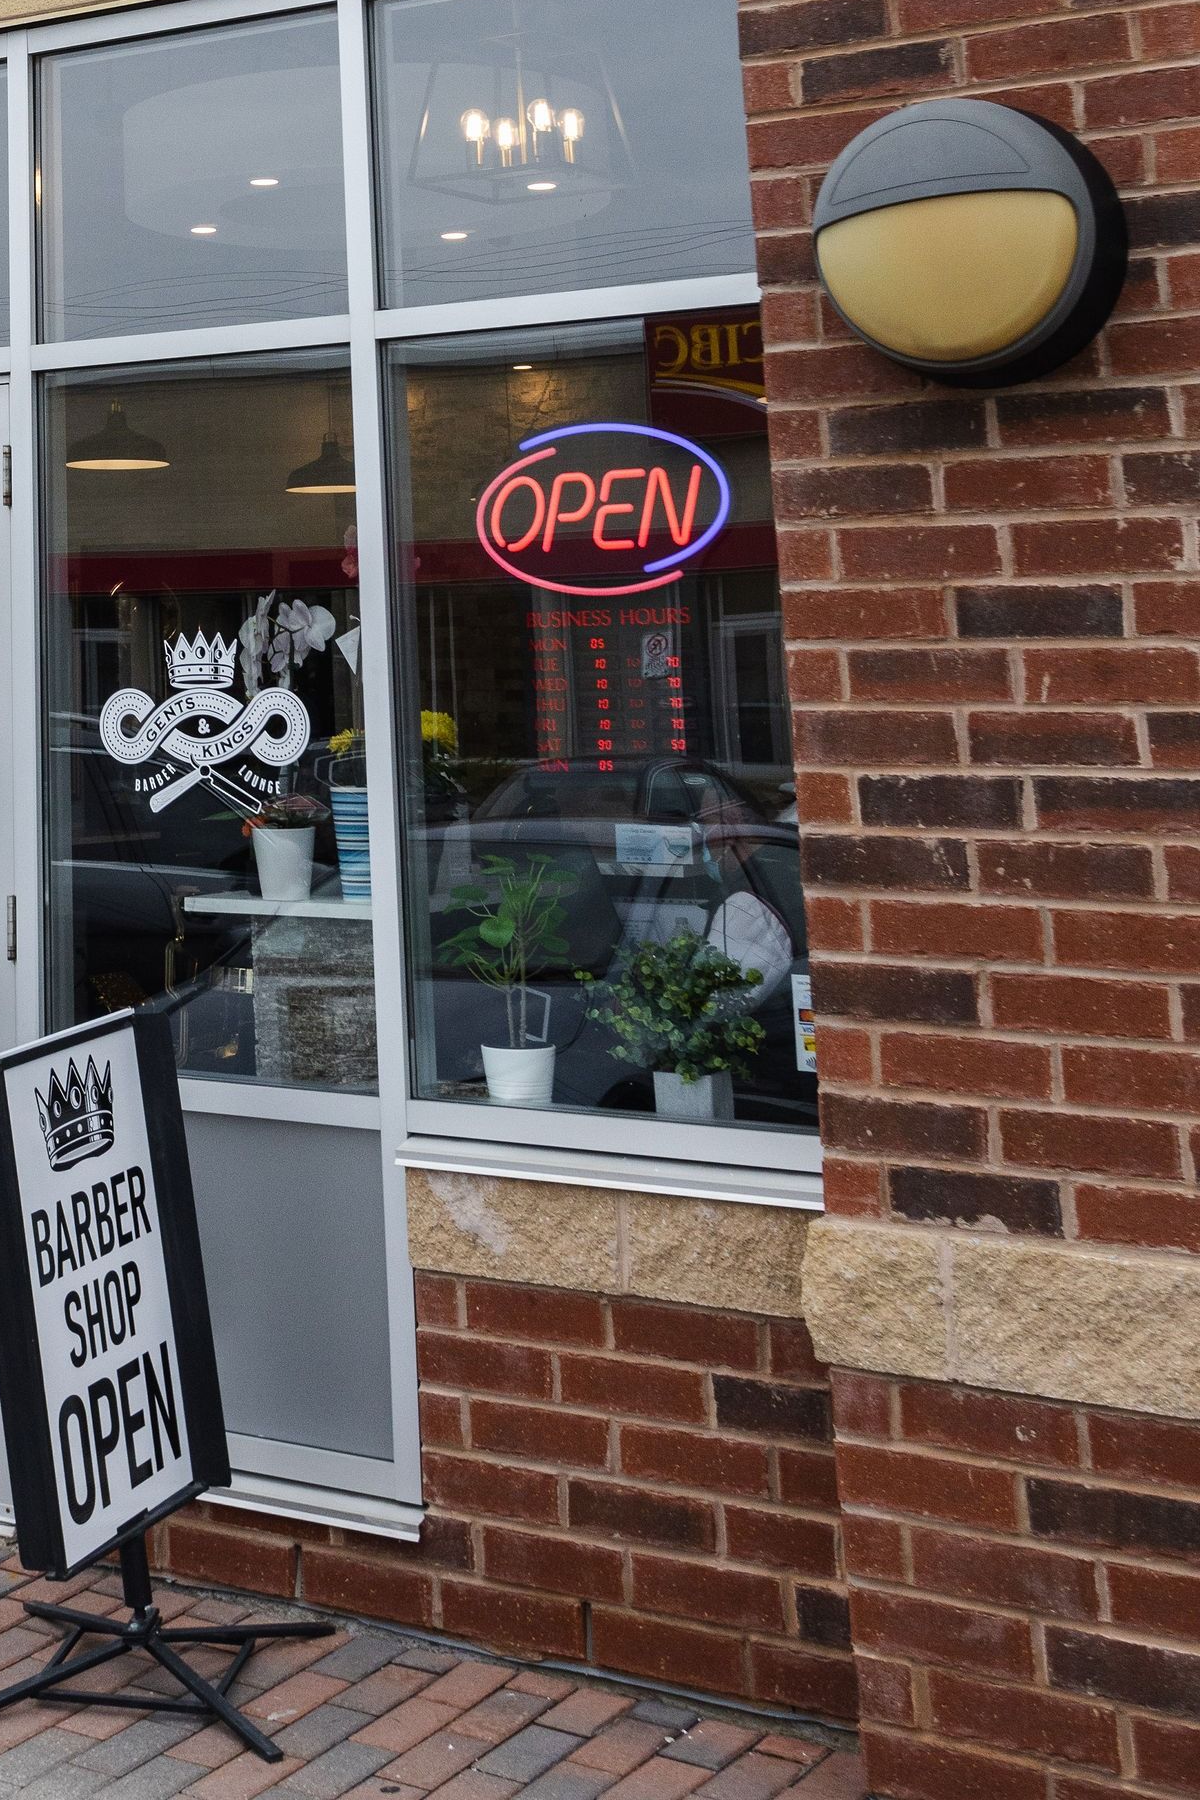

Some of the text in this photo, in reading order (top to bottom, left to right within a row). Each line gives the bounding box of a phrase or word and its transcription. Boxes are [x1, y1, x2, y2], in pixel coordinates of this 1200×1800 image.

[491, 465, 702, 552] OPEN
[527, 606, 691, 628] BUSINESS HOURS
[529, 638, 567, 651] MON
[146, 697, 253, 759] GENTS & KINGS
[135, 763, 281, 794] BARBER LOUNGE
[31, 1165, 152, 1288] BARBER
[64, 1261, 141, 1368] SHOP
[58, 1341, 182, 1525] OPEN
